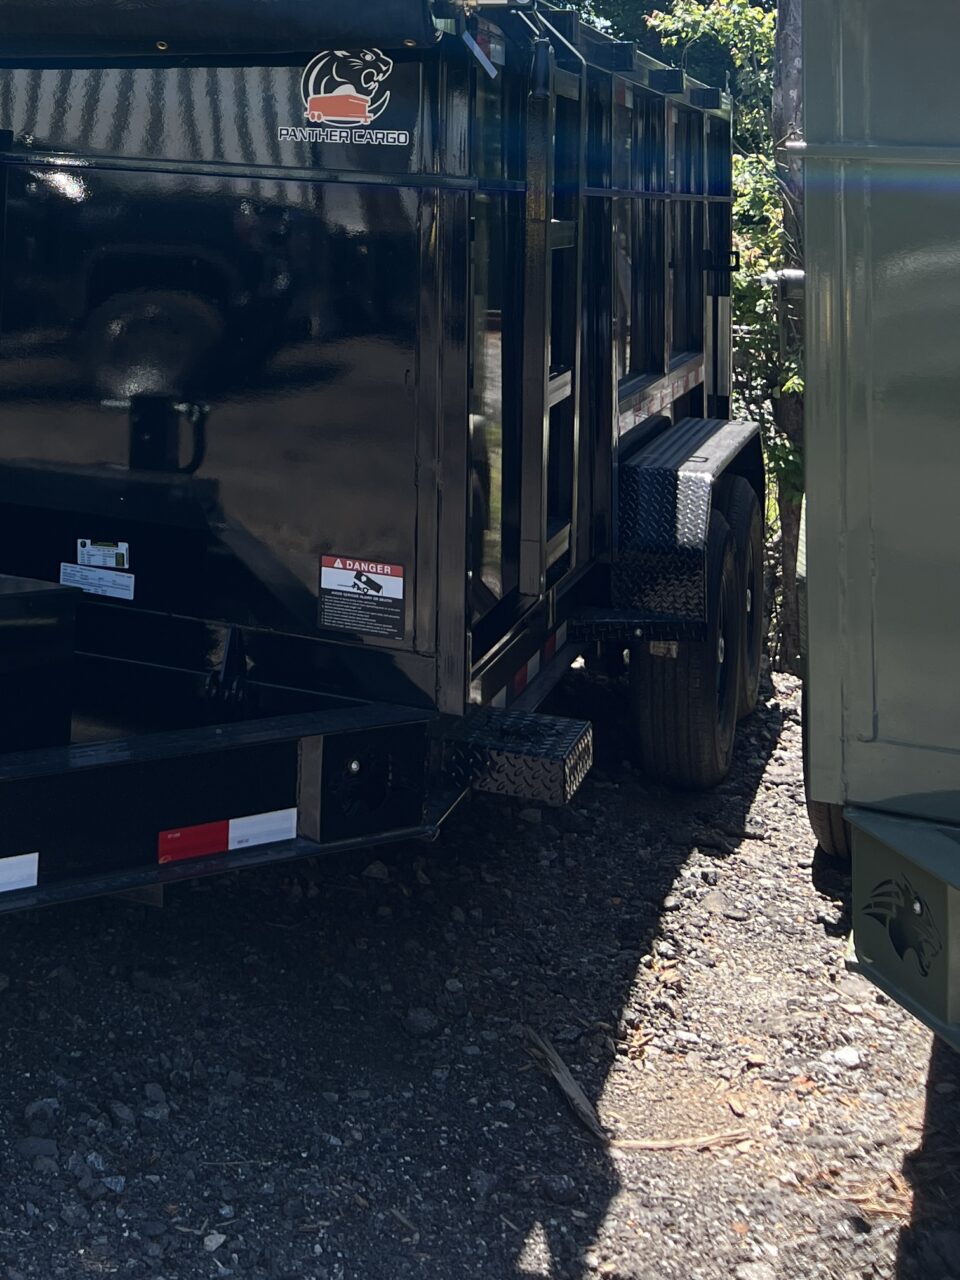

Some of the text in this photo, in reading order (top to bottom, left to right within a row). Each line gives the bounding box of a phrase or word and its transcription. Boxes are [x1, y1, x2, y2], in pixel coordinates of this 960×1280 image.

[278, 127, 409, 145] PANTHER CARGO
[346, 560, 391, 574] DANGER
